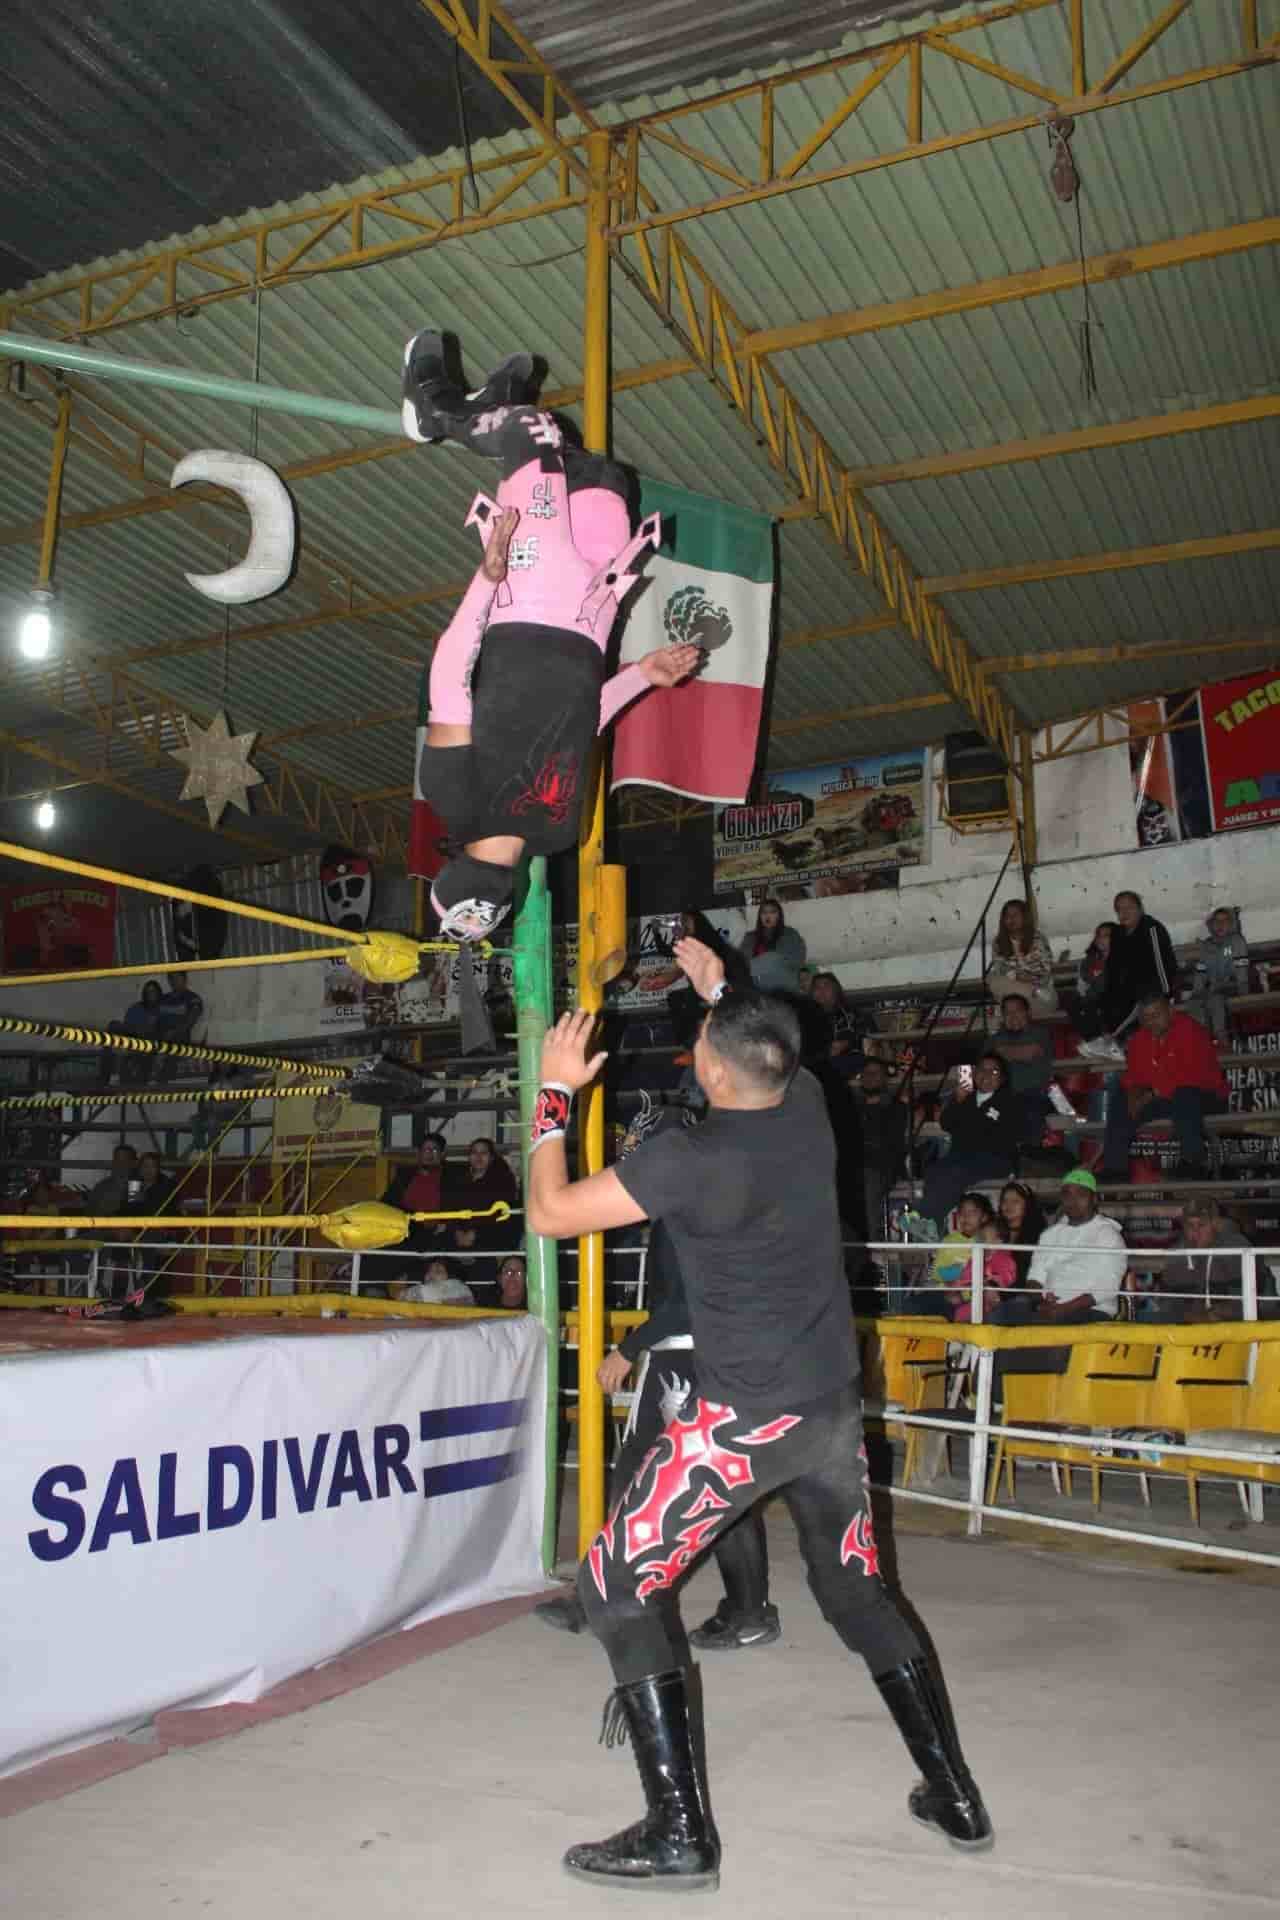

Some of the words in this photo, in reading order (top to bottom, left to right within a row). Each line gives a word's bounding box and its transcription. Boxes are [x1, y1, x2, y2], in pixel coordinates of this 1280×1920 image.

[725, 802, 802, 841] BONANZA
[452, 961, 513, 981] CNTER
[27, 1423, 418, 1562] SALDIVAR
